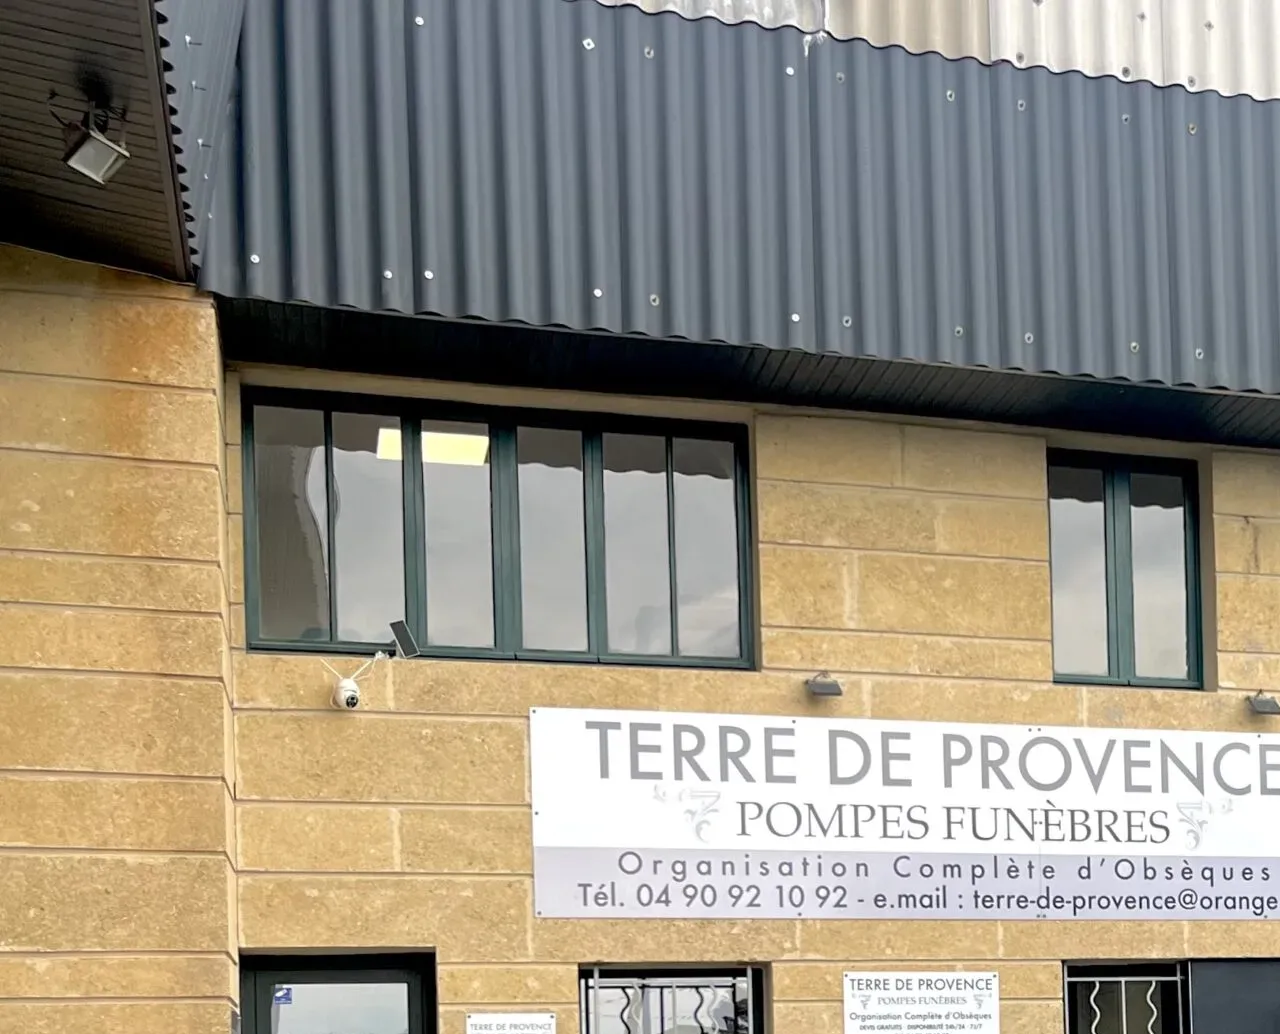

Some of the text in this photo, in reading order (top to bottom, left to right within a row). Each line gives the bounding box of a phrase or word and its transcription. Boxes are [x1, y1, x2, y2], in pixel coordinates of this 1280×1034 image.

[585, 721, 796, 784] TERRE
[828, 729, 912, 786] DE
[736, 800, 1171, 844] POMPES FUNÈBRES
[618, 851, 1271, 887] Organisation Complète d'Obsèques
[578, 883, 624, 907] Tél.
[636, 885, 671, 908] 04
[683, 885, 717, 908] 90
[728, 885, 761, 908] 92
[776, 886, 804, 908] 10
[815, 886, 847, 909] 92
[873, 888, 947, 909] e.mail
[850, 979, 992, 990] TERRE DE PROVENCE
[878, 995, 967, 1005] POMPES FUNÈBRES
[850, 1012, 902, 1022] Organisation
[905, 1012, 942, 1022] Complète
